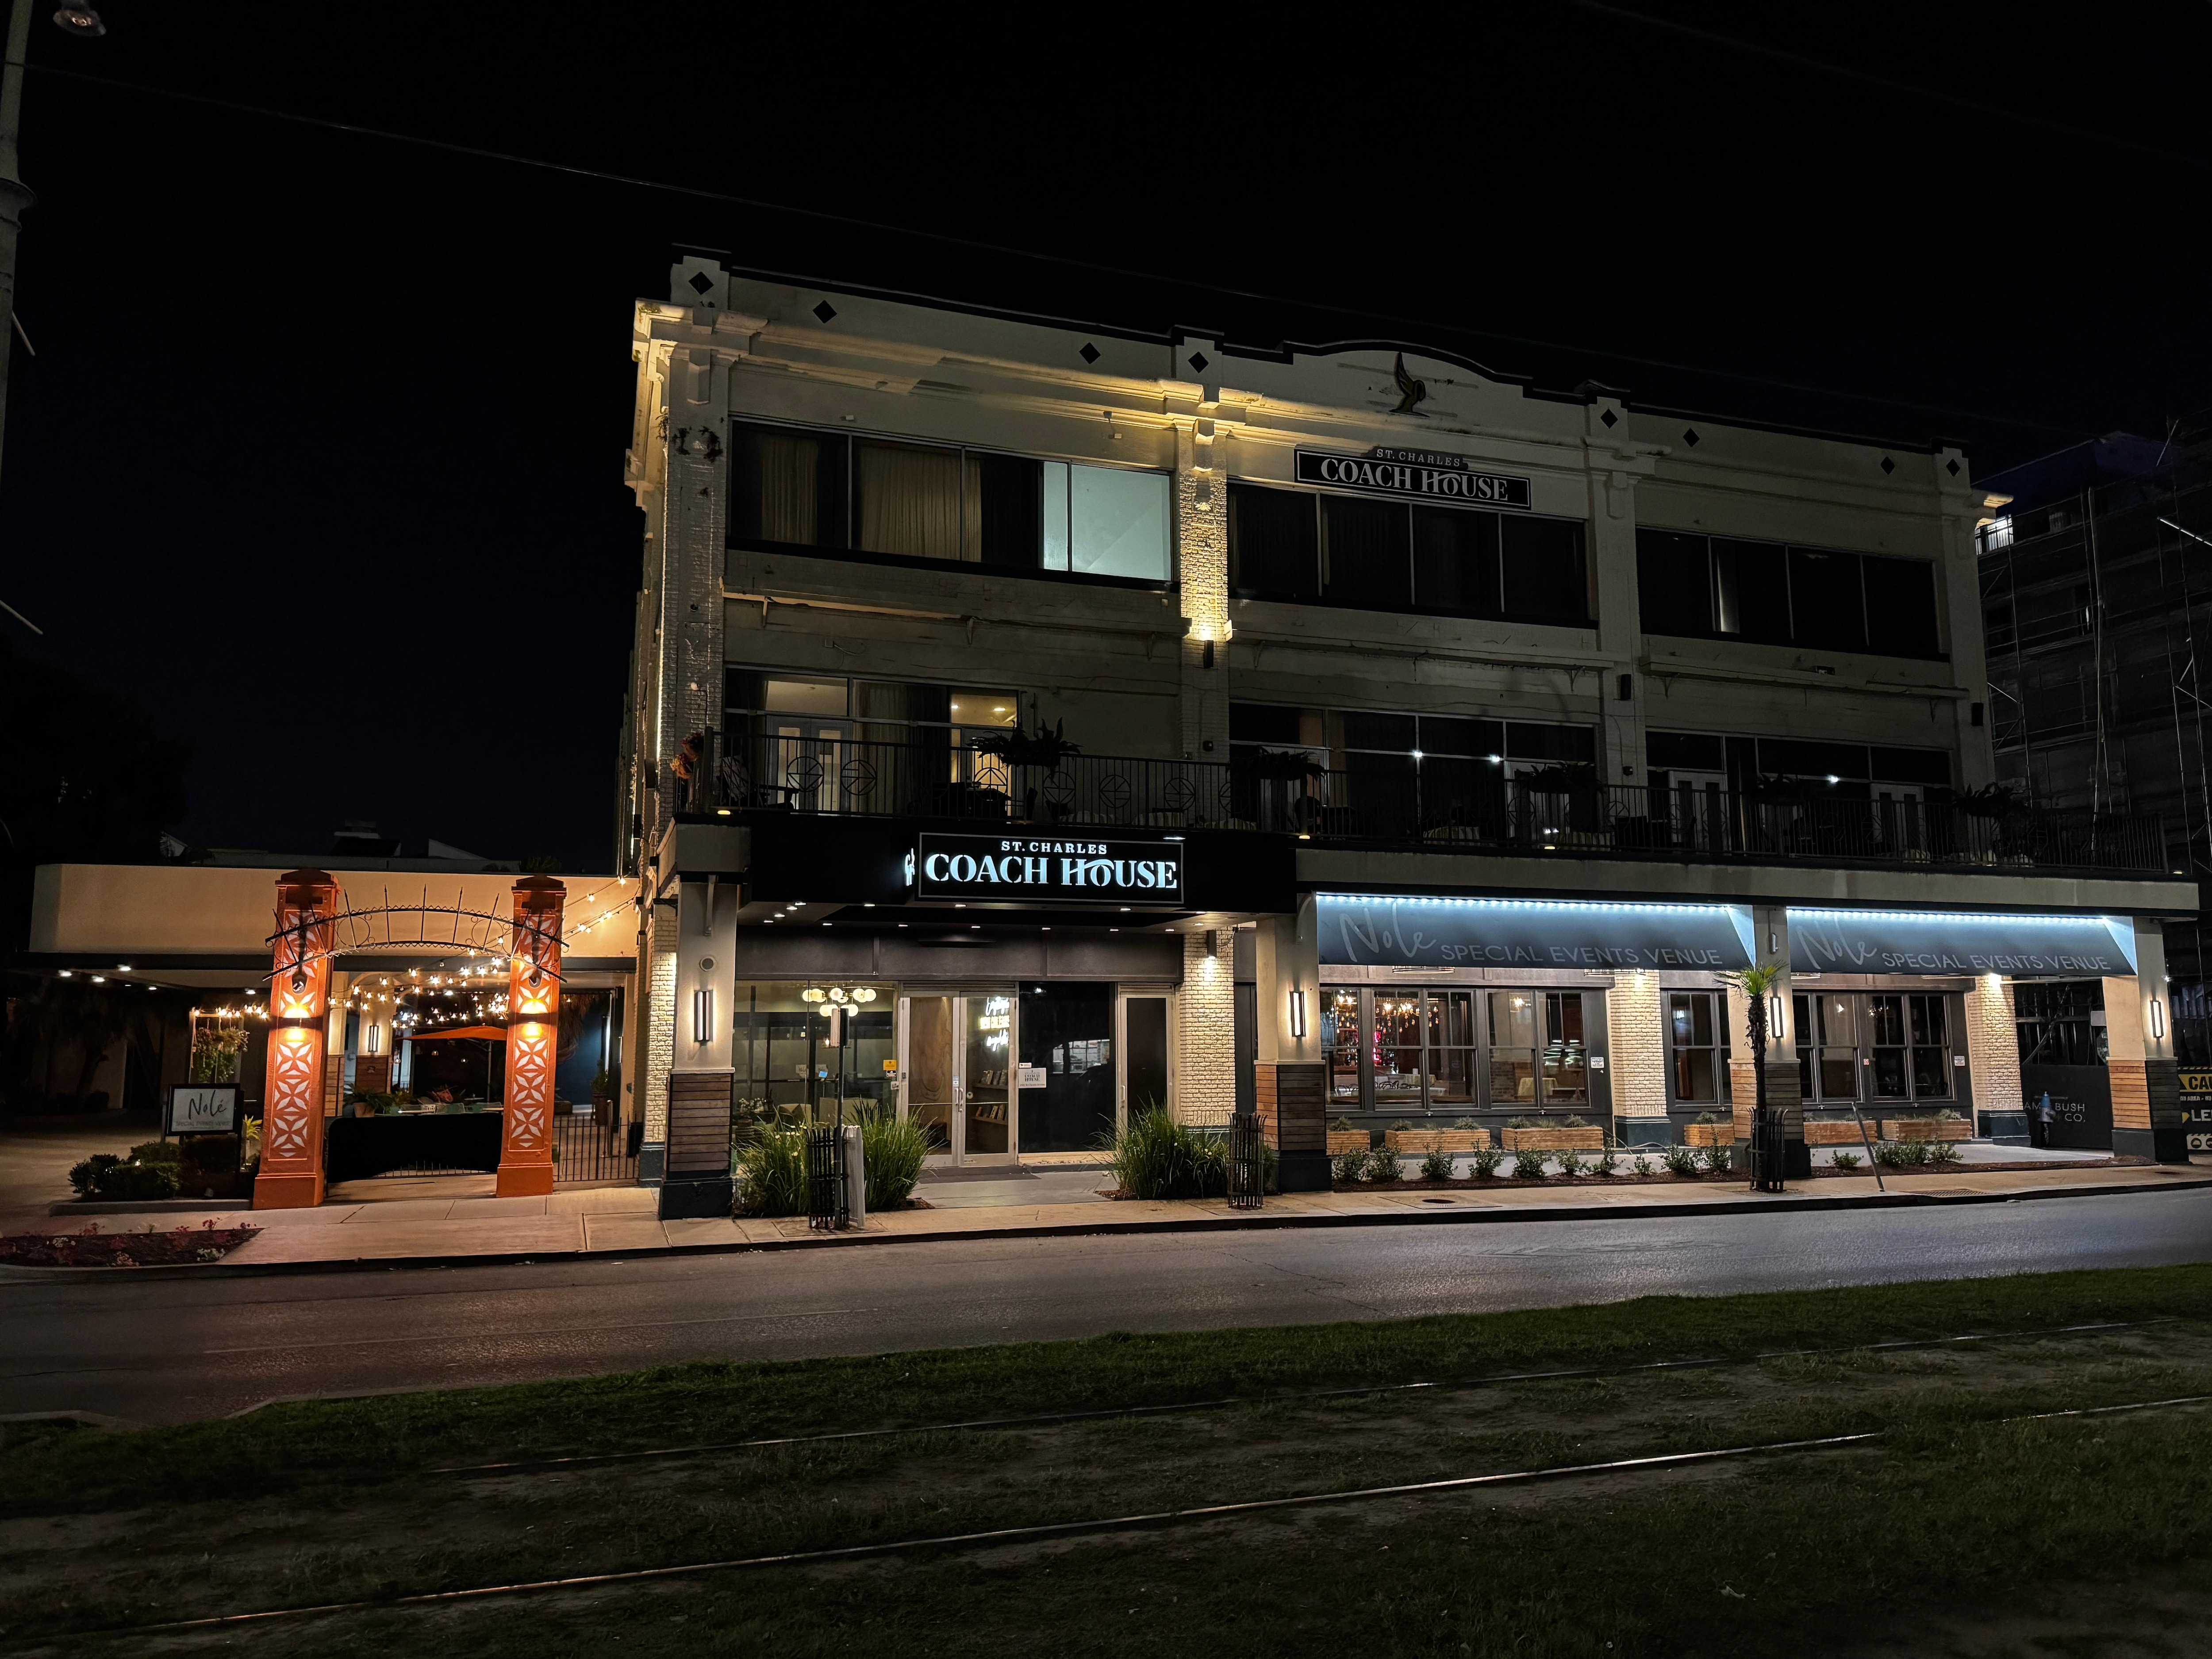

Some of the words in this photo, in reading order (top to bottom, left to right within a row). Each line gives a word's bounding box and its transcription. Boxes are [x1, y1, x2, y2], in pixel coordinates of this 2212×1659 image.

[1376, 449, 1395, 459] ST.
[1398, 452, 1460, 467] CHARLES
[1321, 458, 1412, 489] COACH
[1421, 469, 1508, 501] HOUSE
[1001, 841, 1025, 852] ST.
[1030, 842, 1107, 854] CHARLES
[926, 853, 1049, 884] COACH
[1061, 858, 1177, 889] HOUSE
[1441, 945, 1543, 962] SPECIAL
[1549, 946, 1640, 963] EVENTS
[1643, 949, 1722, 965] VENUE
[1882, 952, 1967, 968] SPECIAL
[1970, 954, 2045, 970] EVENTS
[2046, 956, 2112, 971] VENUE
[2055, 1102, 2085, 1112] BUSH
